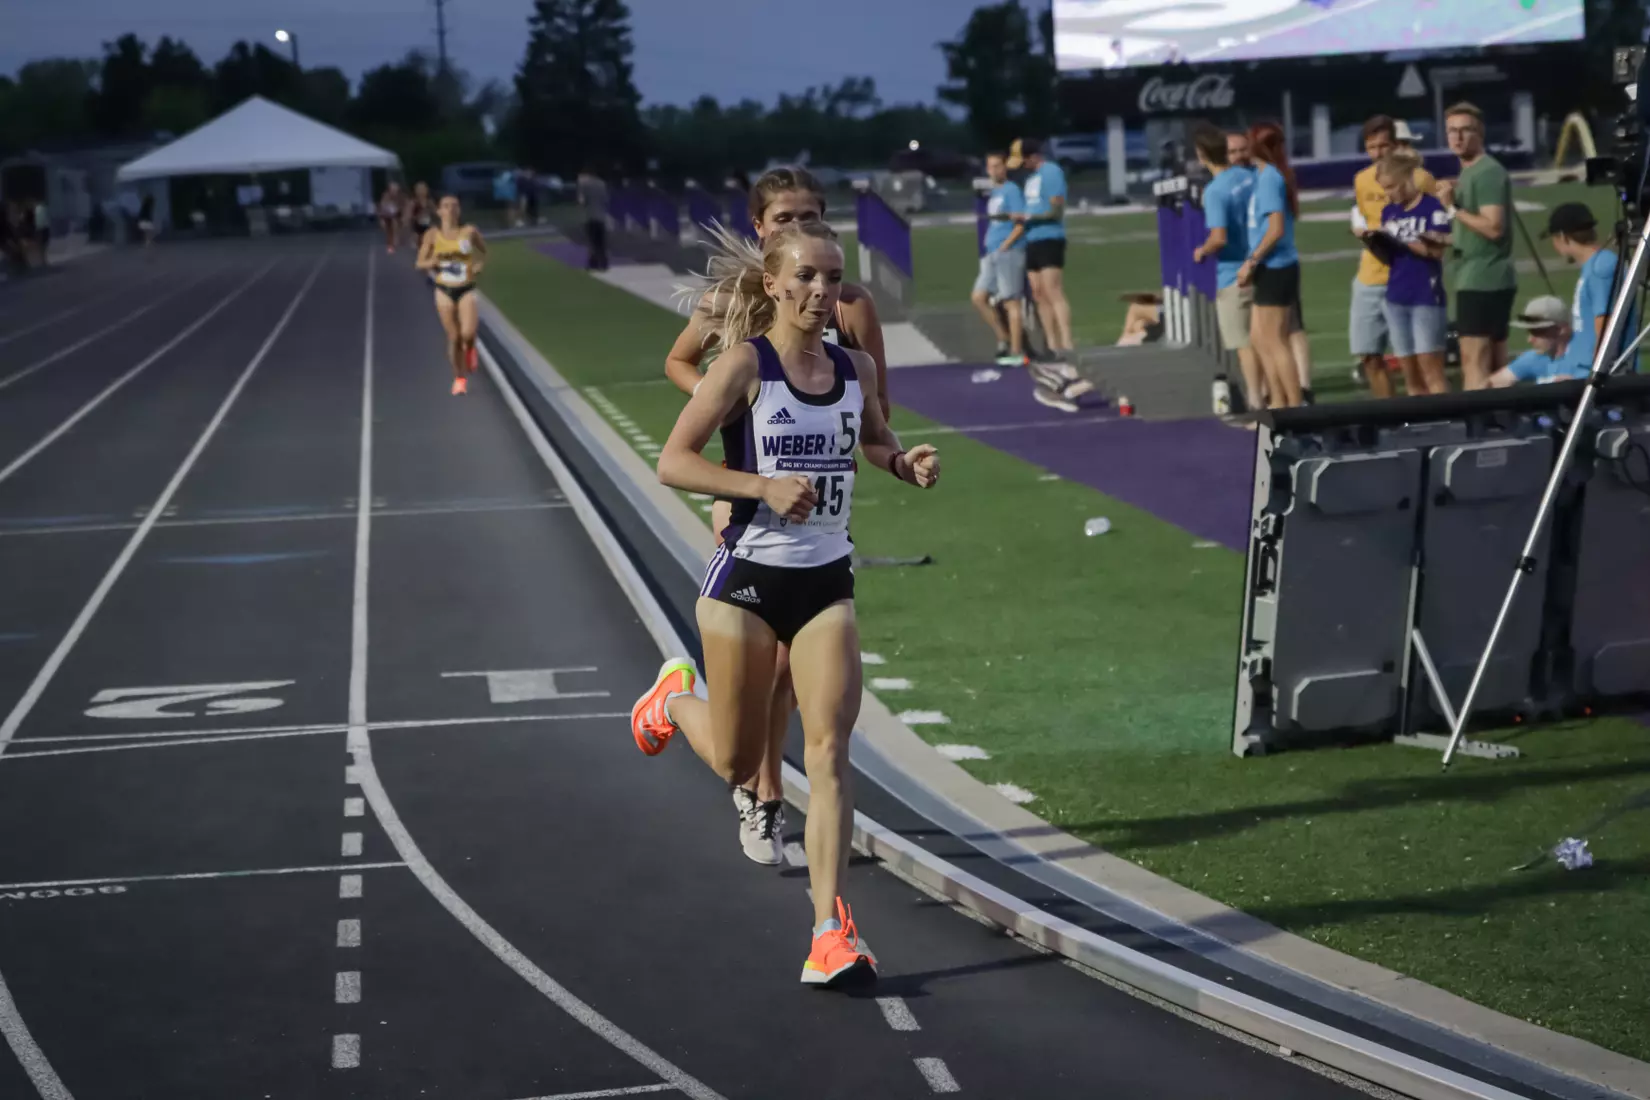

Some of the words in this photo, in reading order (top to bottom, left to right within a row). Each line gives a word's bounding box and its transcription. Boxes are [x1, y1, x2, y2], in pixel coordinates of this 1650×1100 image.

[767, 417, 796, 425] adidas
[762, 434, 826, 457] WEBER
[840, 412, 856, 456] 5
[801, 474, 844, 516] 45
[730, 592, 761, 604] adidas
